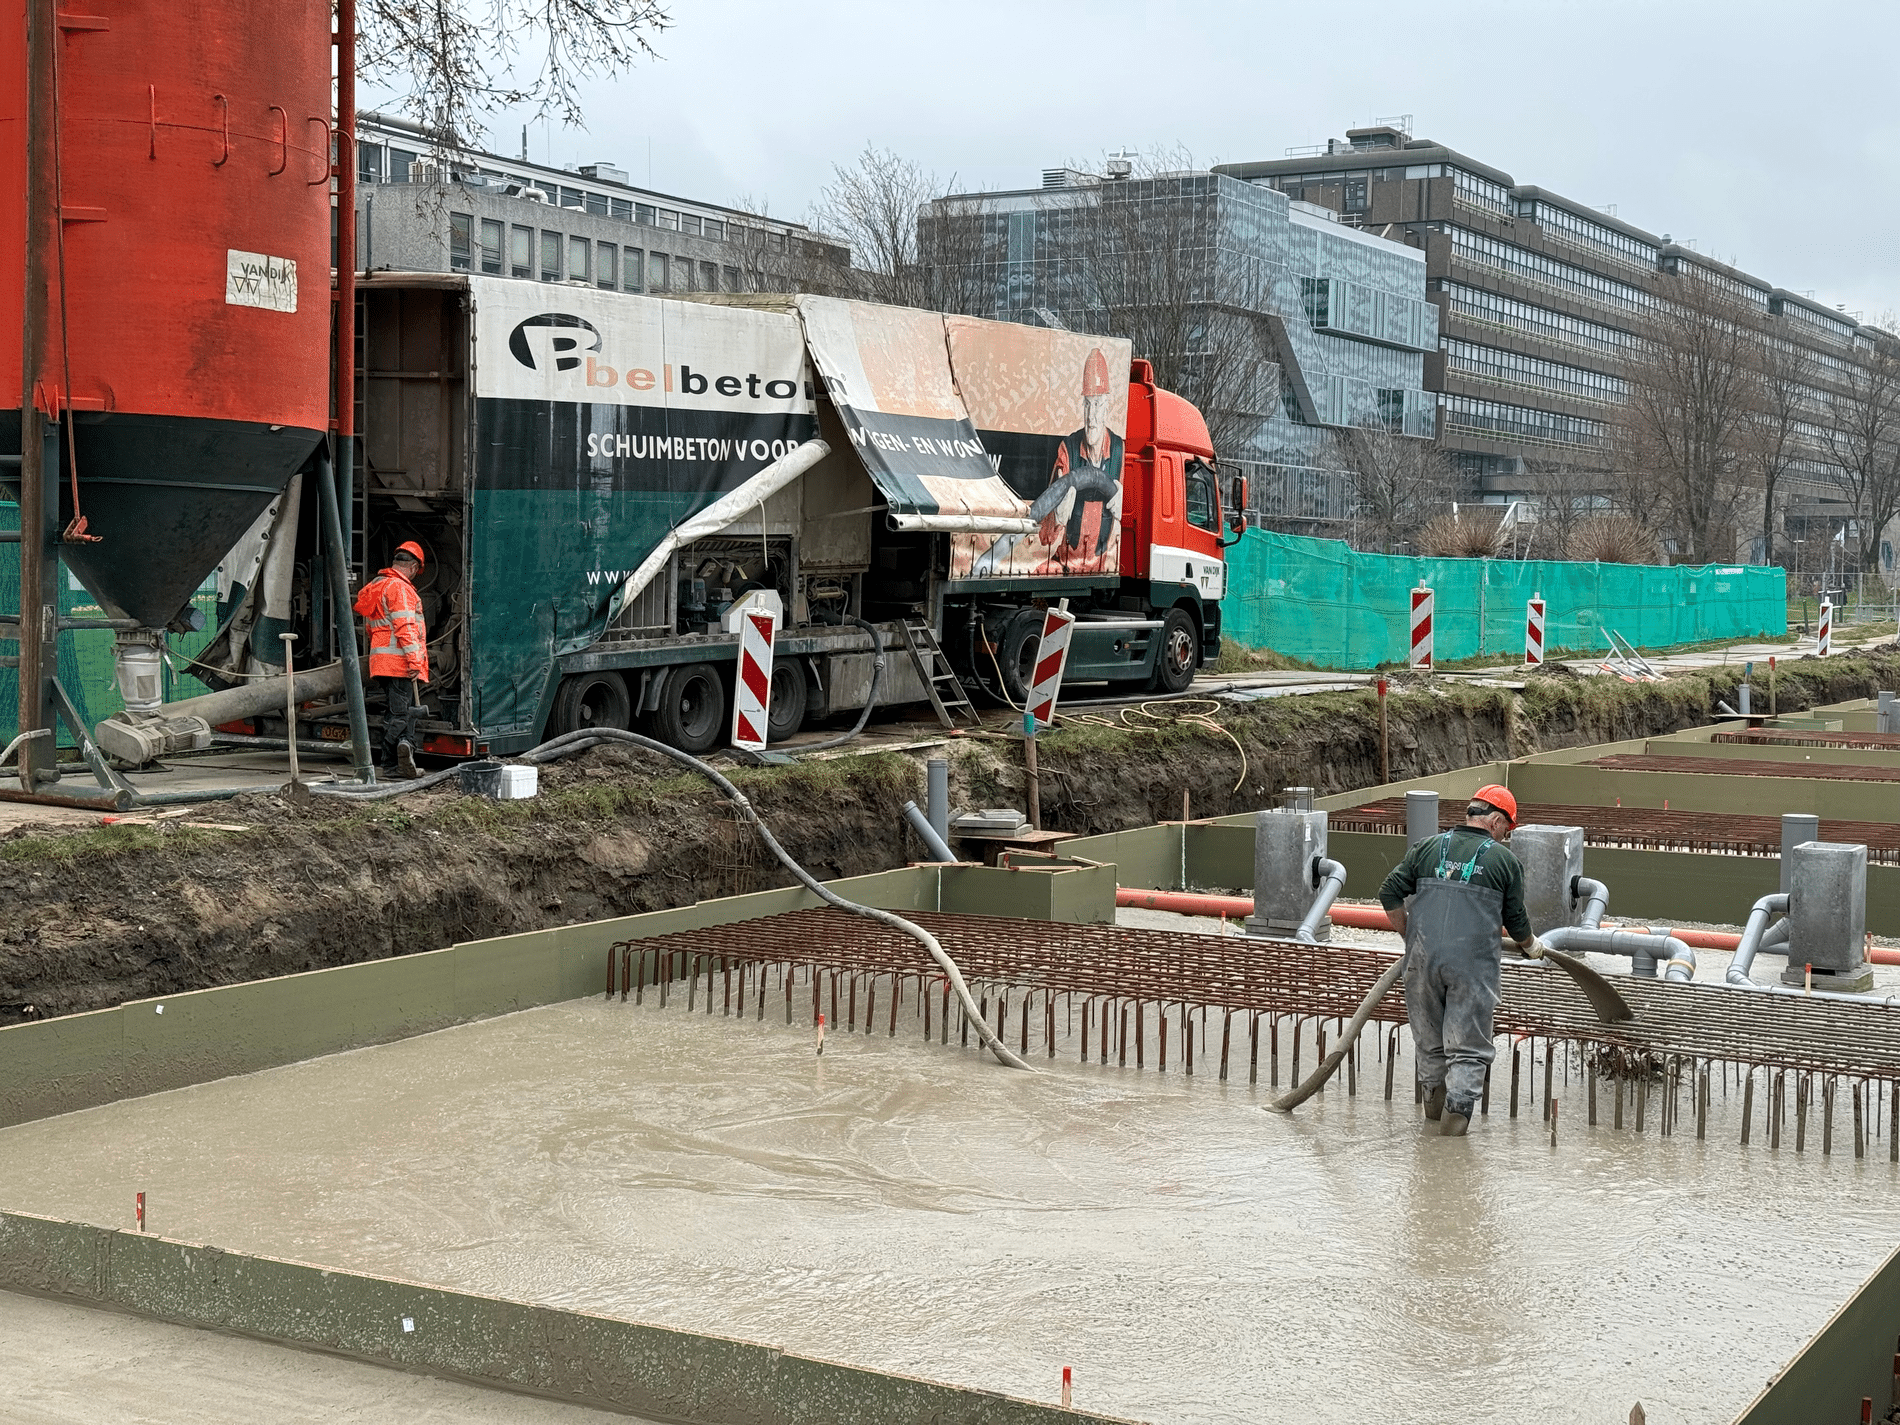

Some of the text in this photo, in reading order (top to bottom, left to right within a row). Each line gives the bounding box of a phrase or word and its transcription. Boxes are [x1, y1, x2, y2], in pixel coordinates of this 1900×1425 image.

[241, 262, 268, 278] VAN
[587, 433, 731, 461] SCHUIMBETON
[911, 436, 938, 456] EN
